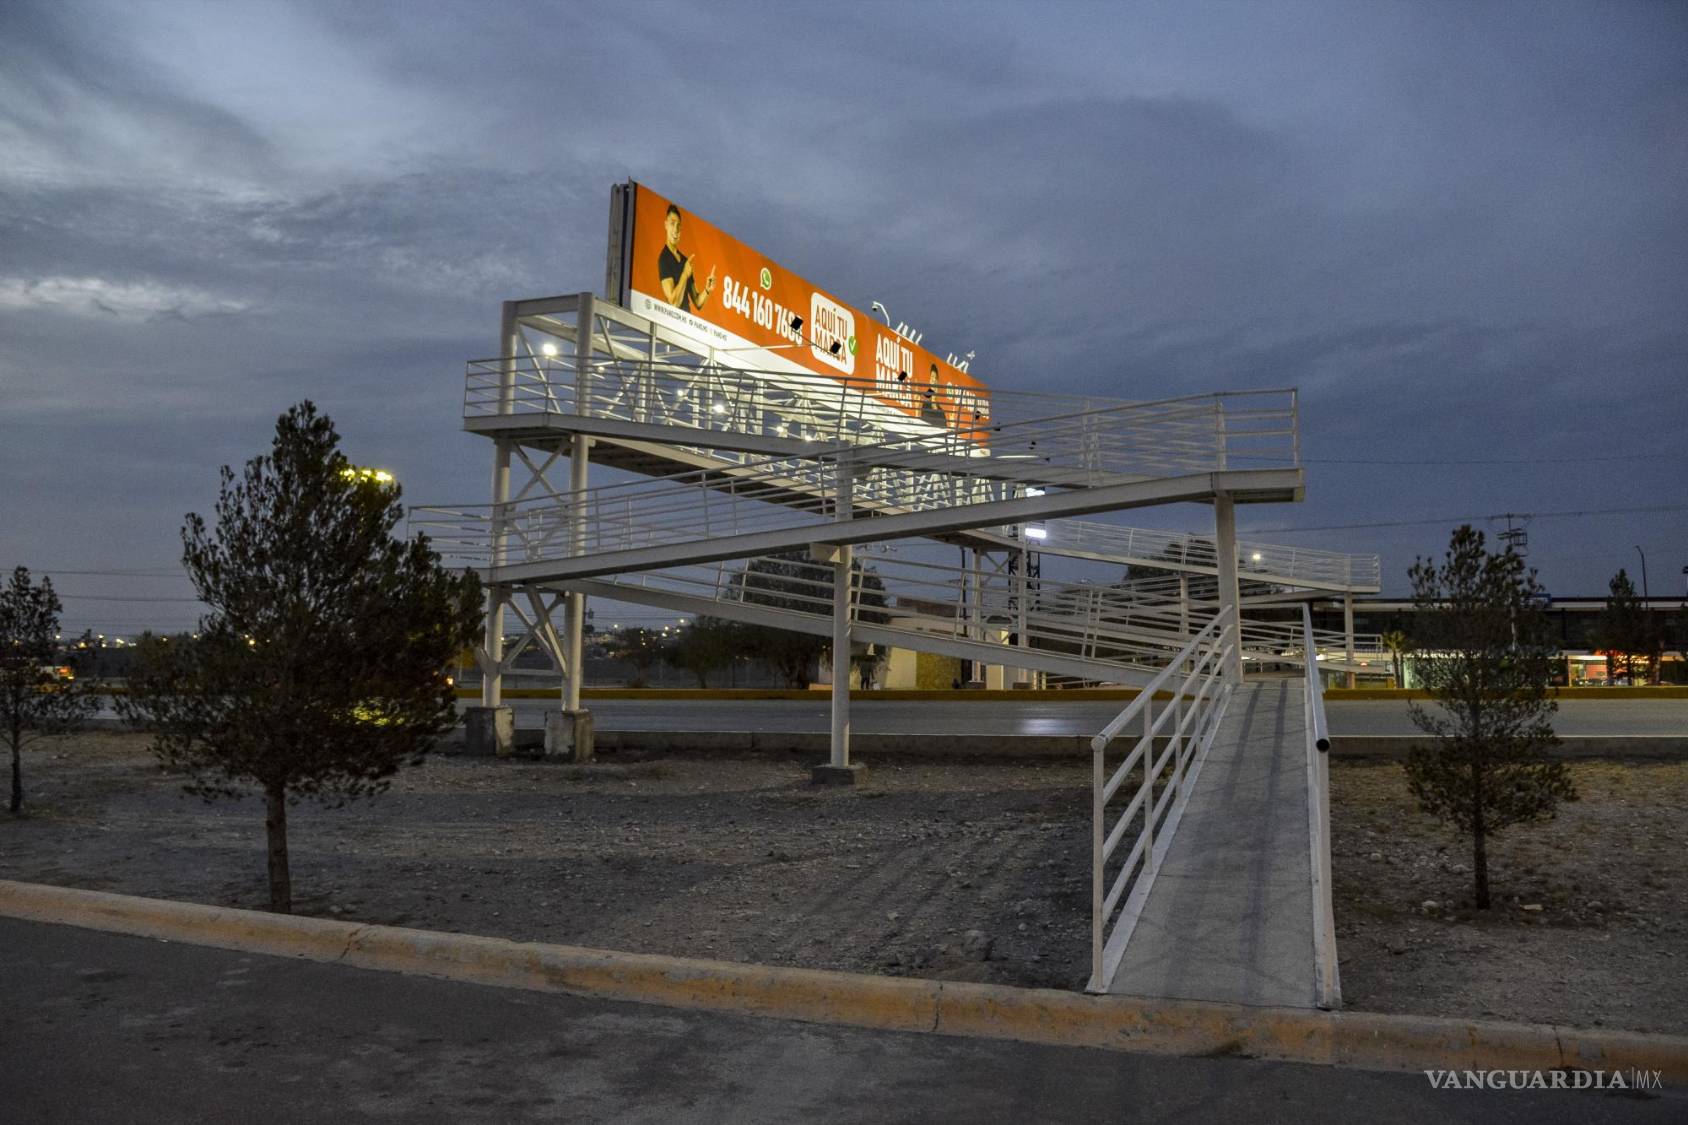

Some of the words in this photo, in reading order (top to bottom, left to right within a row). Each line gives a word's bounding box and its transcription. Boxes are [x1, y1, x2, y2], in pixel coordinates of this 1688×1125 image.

[723, 275, 750, 319] 844
[752, 291, 773, 330] 160
[815, 304, 836, 335] AQUÍ
[837, 316, 848, 340] TU
[876, 333, 900, 373] AQUÍ
[900, 346, 913, 379] TU
